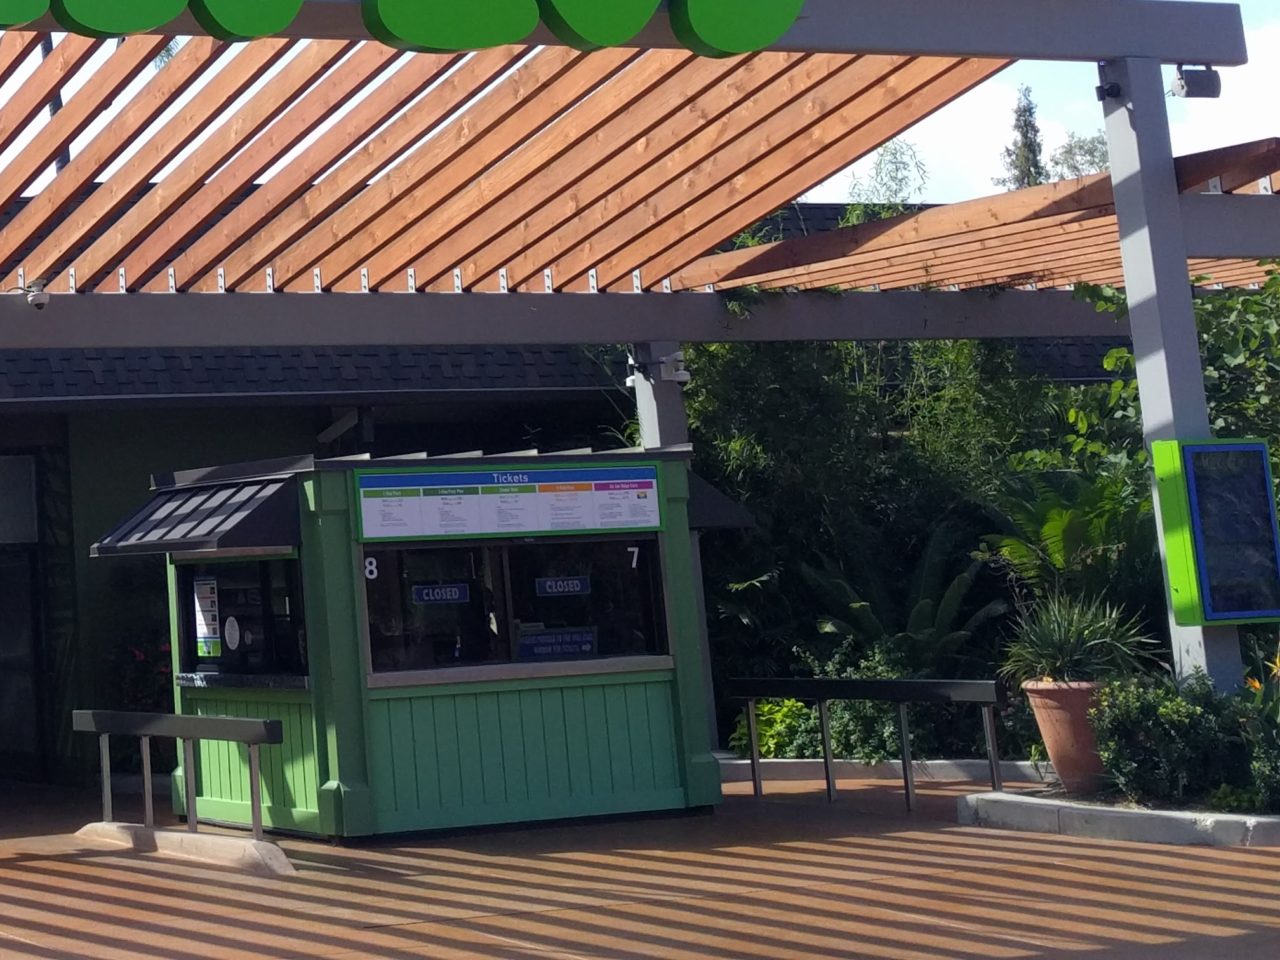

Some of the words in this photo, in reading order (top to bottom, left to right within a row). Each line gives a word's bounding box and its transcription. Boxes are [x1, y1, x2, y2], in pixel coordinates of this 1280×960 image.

[492, 473, 529, 483] Tickets
[627, 547, 639, 569] 7
[364, 557, 378, 580] 8
[545, 580, 581, 593] CLOSED
[423, 588, 459, 600] CLOSED
